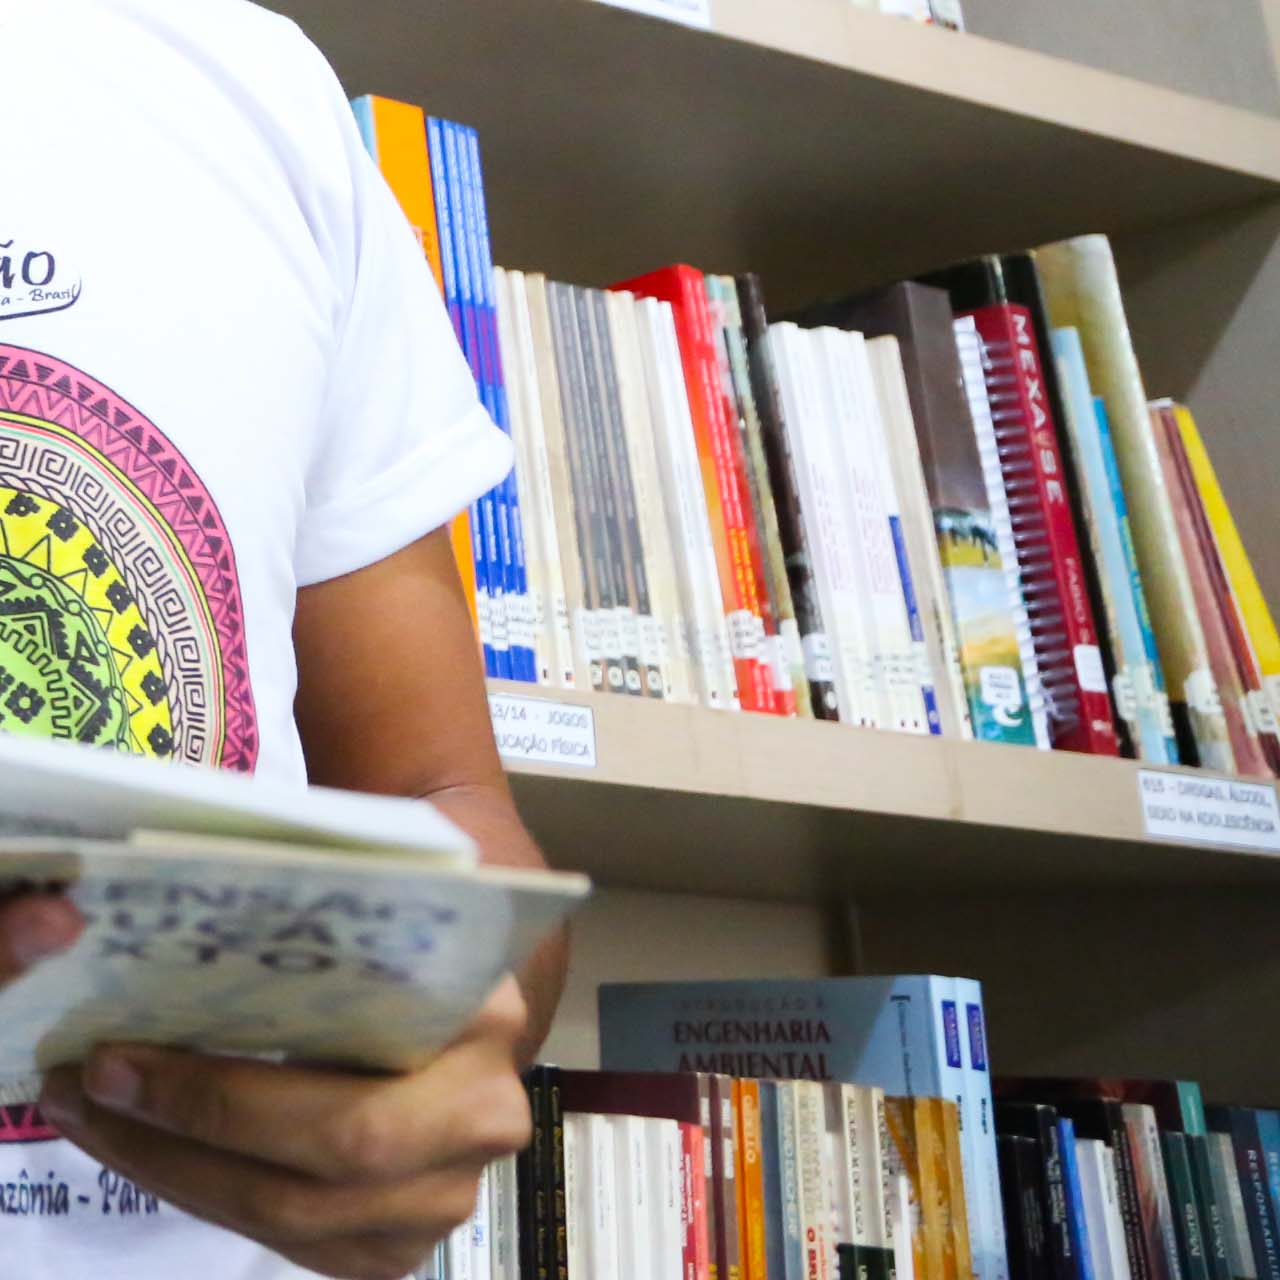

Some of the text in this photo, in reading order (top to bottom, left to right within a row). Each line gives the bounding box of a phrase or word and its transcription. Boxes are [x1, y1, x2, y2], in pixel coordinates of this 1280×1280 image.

[29, 285, 81, 303] Brasil
[495, 735, 548, 753] UCAÇÃO
[673, 1021, 832, 1044] ENGENHARIA
